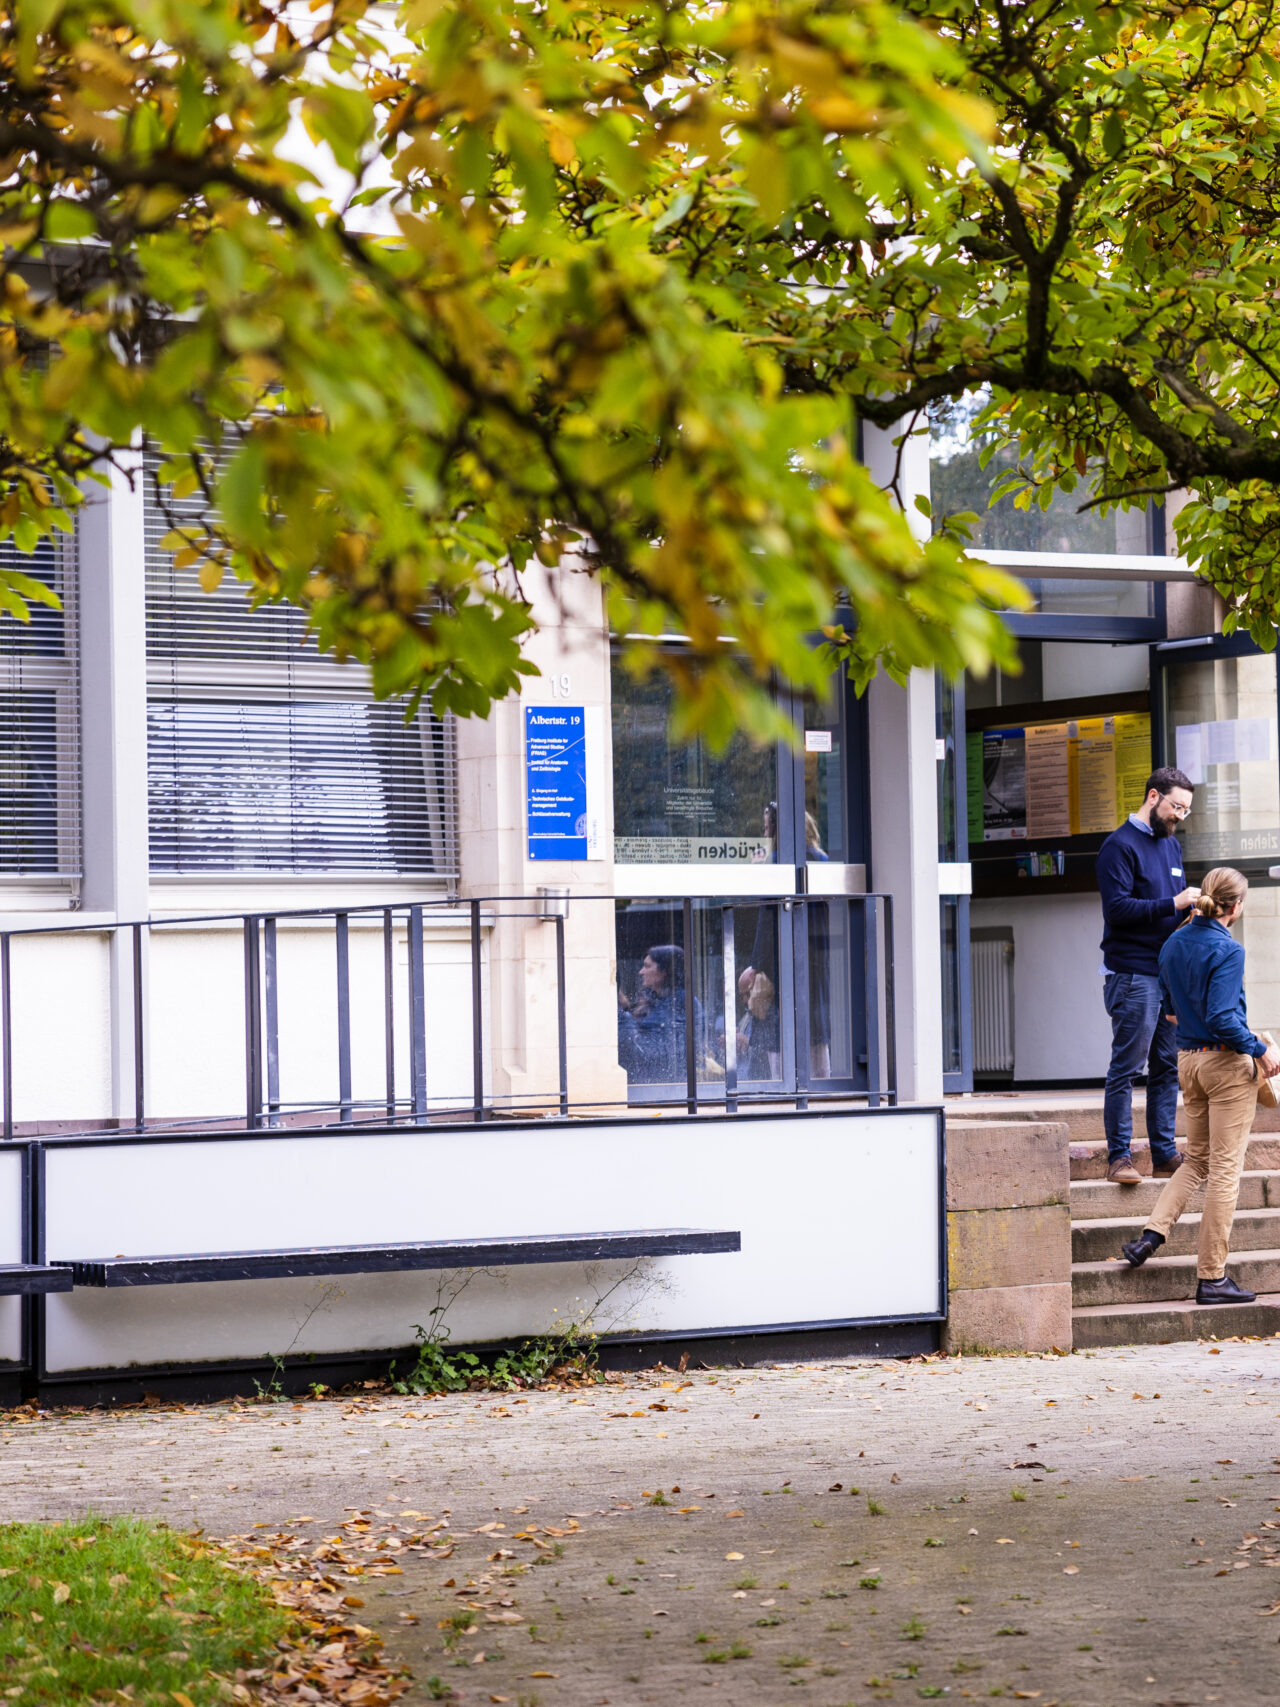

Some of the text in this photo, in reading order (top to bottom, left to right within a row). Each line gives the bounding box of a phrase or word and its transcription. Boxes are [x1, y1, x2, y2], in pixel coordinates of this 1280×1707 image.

[550, 673, 571, 698] 19
[530, 715, 581, 725] Albertstr. 19
